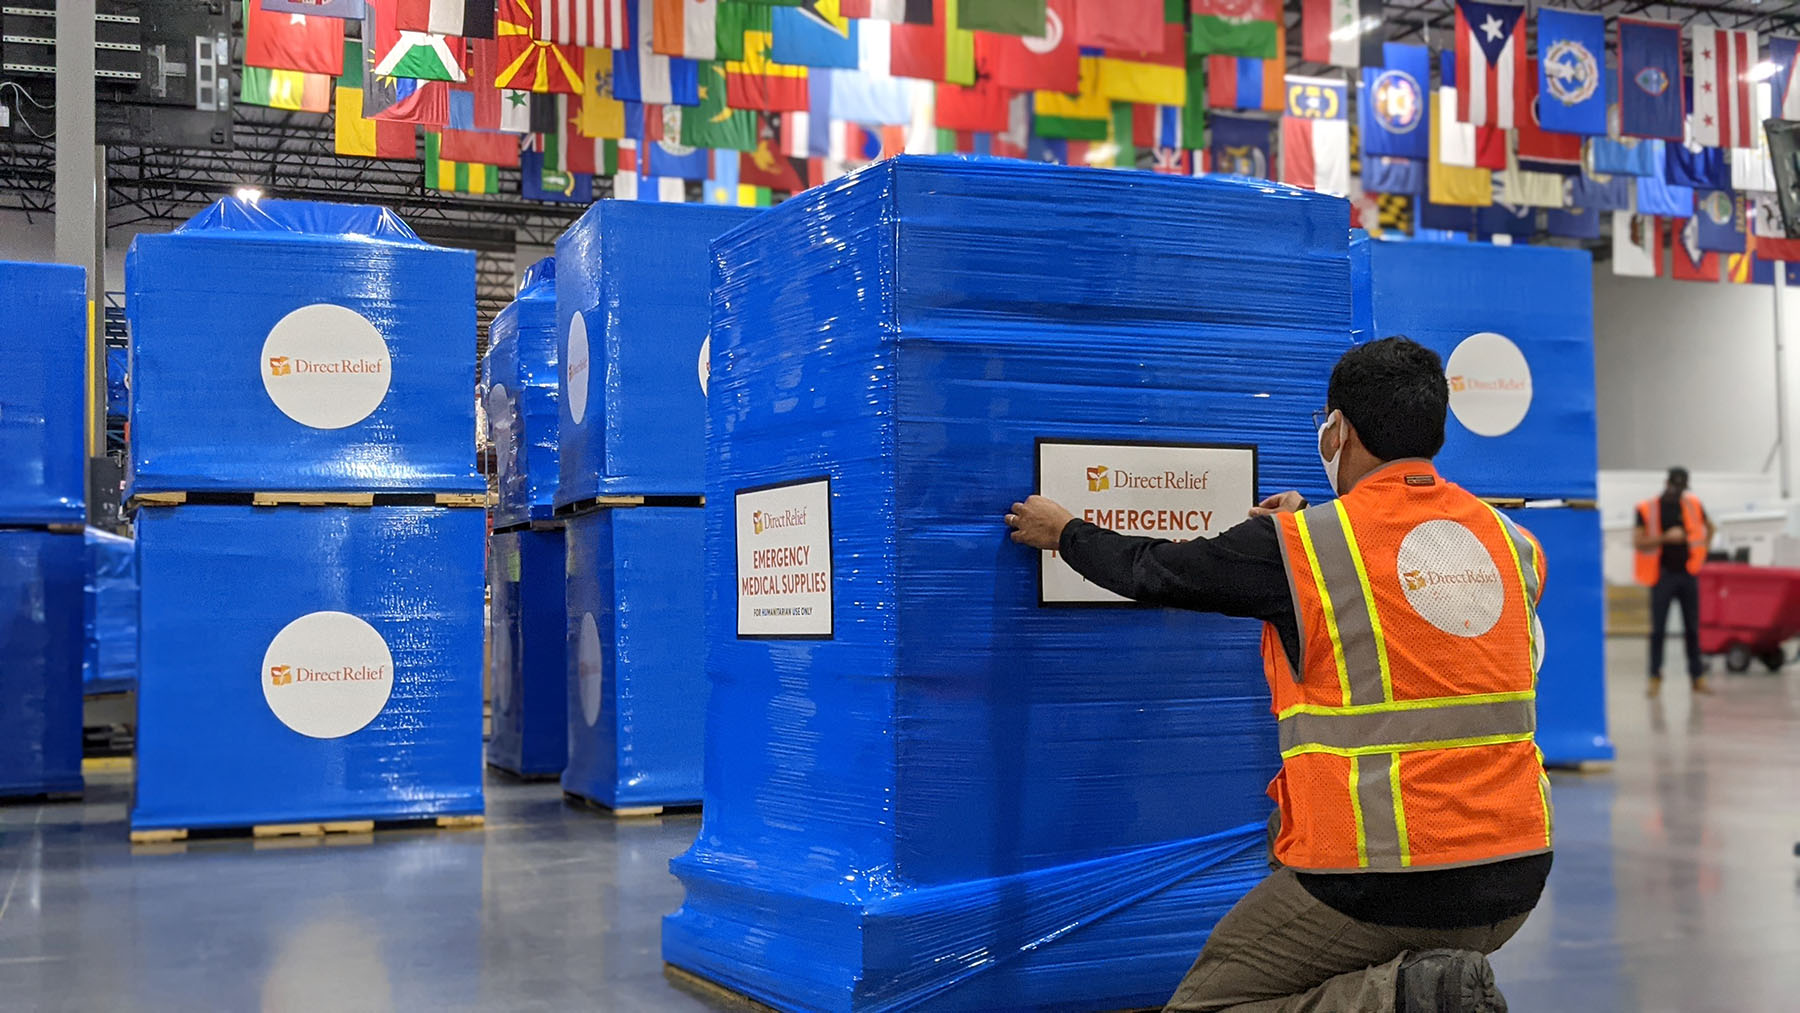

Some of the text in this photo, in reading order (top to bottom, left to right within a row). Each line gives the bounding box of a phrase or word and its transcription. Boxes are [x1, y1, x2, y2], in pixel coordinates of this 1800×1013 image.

[296, 358, 382, 373] Direct Relief
[1114, 470, 1209, 490] Direct Relief
[764, 507, 807, 529] Direct Relief
[1084, 509, 1213, 531] EMERGENCY
[753, 545, 810, 569] EMERGENCY
[742, 572, 827, 597] MEDICAL SUPPLIES
[1427, 571, 1467, 586] Direct
[753, 607, 813, 617] FOR HUMANITARIAN USE ONLY
[297, 665, 385, 682] Direct Relief
